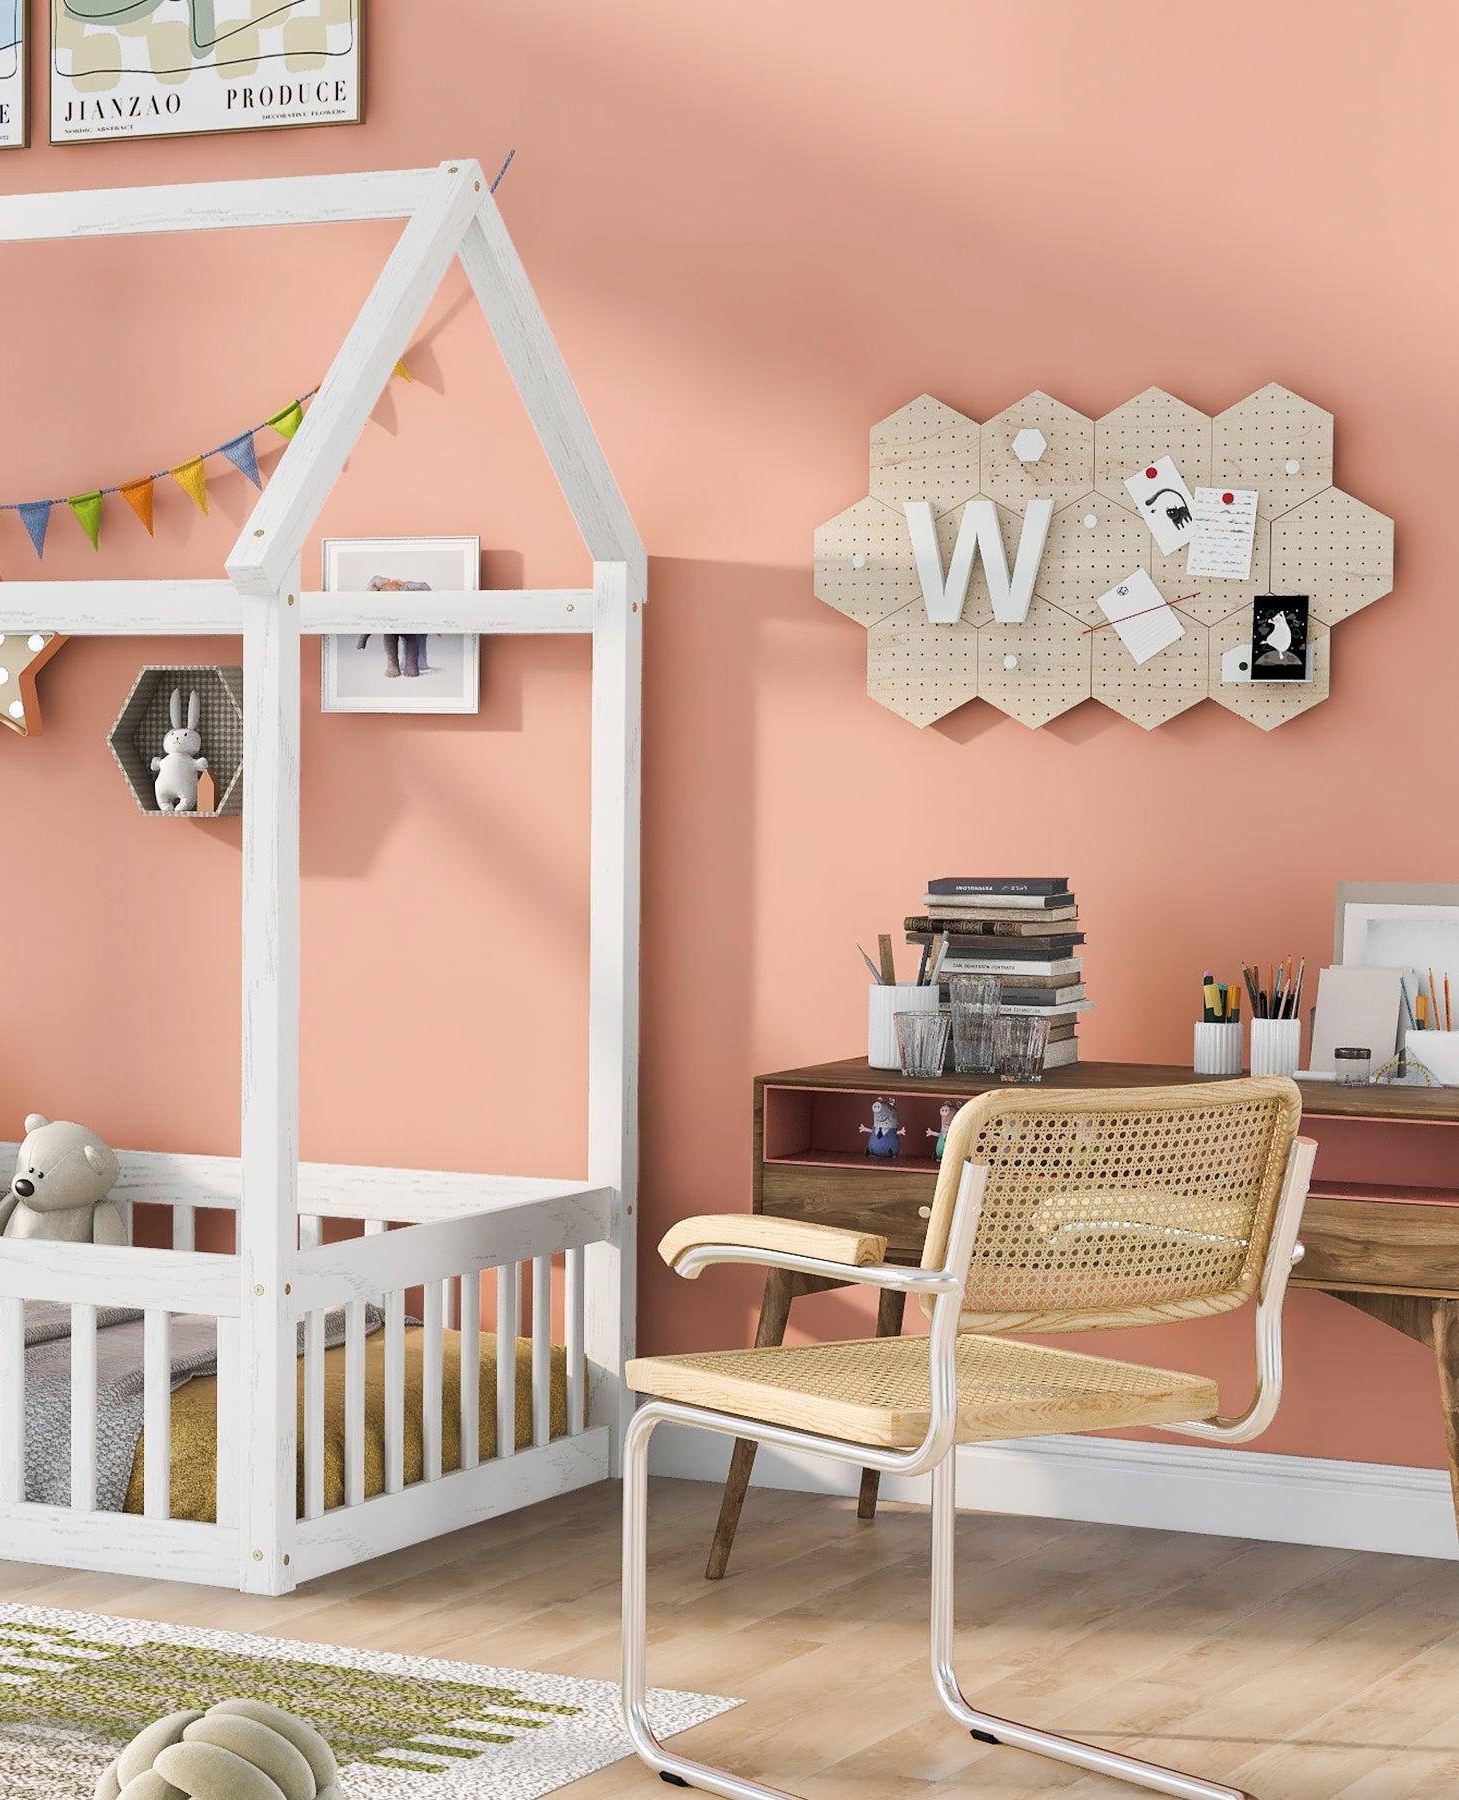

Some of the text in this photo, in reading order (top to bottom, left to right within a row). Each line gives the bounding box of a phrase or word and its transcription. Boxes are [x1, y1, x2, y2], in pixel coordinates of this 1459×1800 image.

[64, 80, 347, 122] JIANZAO PRODUCE
[903, 499, 1055, 623] W
